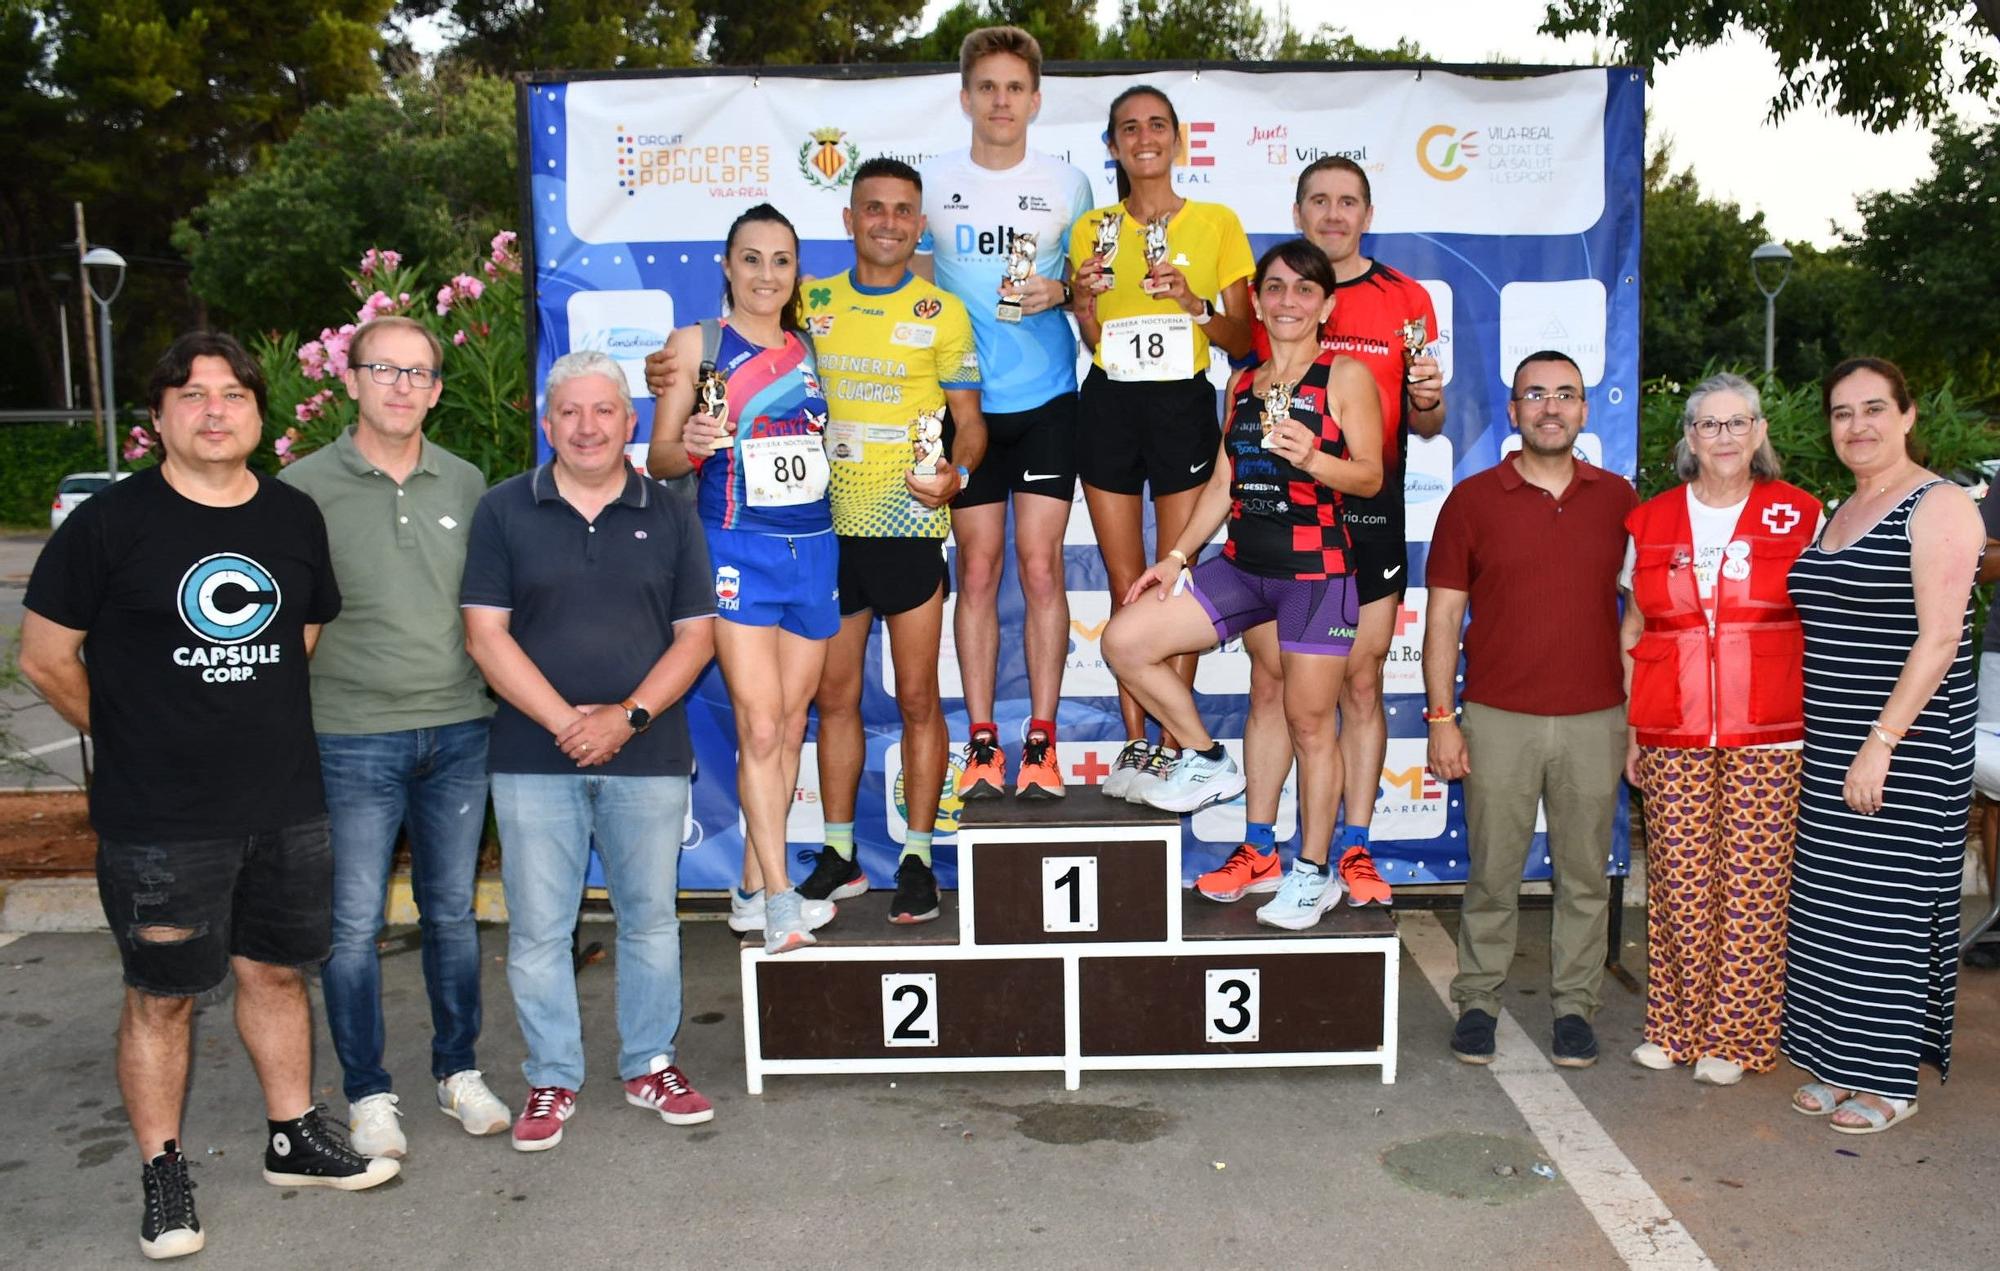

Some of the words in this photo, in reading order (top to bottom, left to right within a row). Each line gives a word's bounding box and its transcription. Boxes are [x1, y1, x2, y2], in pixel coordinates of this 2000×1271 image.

[956, 223, 1018, 255] Delt
[1129, 333, 1164, 359] 18
[774, 454, 806, 482] 80
[173, 644, 280, 667] CAPSULE
[202, 666, 257, 683] CORP.
[1053, 866, 1082, 923] 1
[891, 984, 930, 1039] 2
[1213, 979, 1251, 1035] 3
